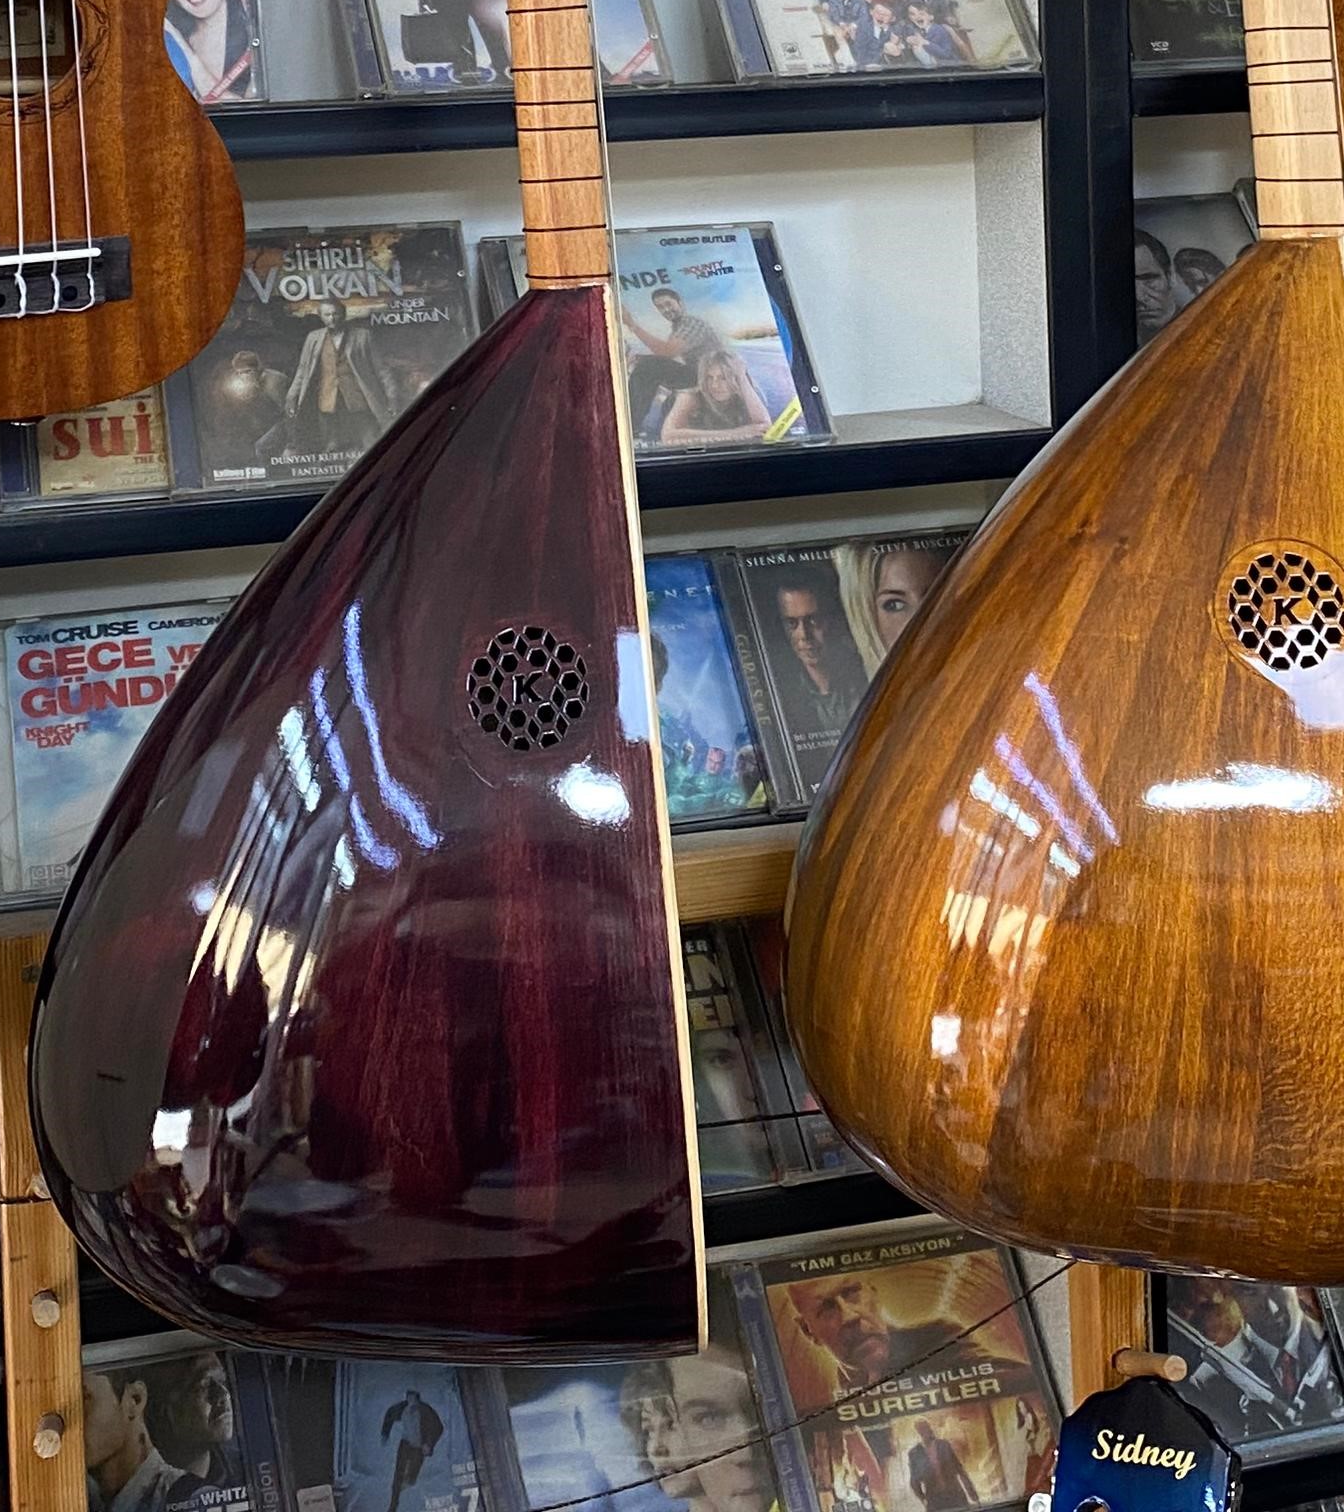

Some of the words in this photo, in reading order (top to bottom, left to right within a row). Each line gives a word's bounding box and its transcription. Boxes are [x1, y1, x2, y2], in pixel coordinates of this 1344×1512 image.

[281, 239, 364, 273] SİHİRLİ
[659, 236, 701, 247] GERARD
[701, 234, 737, 245] BUTLER
[244, 259, 405, 305] VOLKAN
[370, 306, 451, 327] MOUNTAIN
[744, 551, 796, 569] SIENNA
[871, 538, 910, 555] STEVE
[16, 631, 51, 646] TOM
[50, 619, 141, 645] CRUISE
[147, 613, 222, 632] CAMERON
[15, 636, 156, 682] GECE
[839, 1249, 876, 1266] GAZ
[879, 1236, 953, 1259] AKSİYON
[919, 1362, 995, 1386] WILLIS
[836, 1377, 1002, 1423] SURETLER
[1091, 1428, 1199, 1480] Sidney
